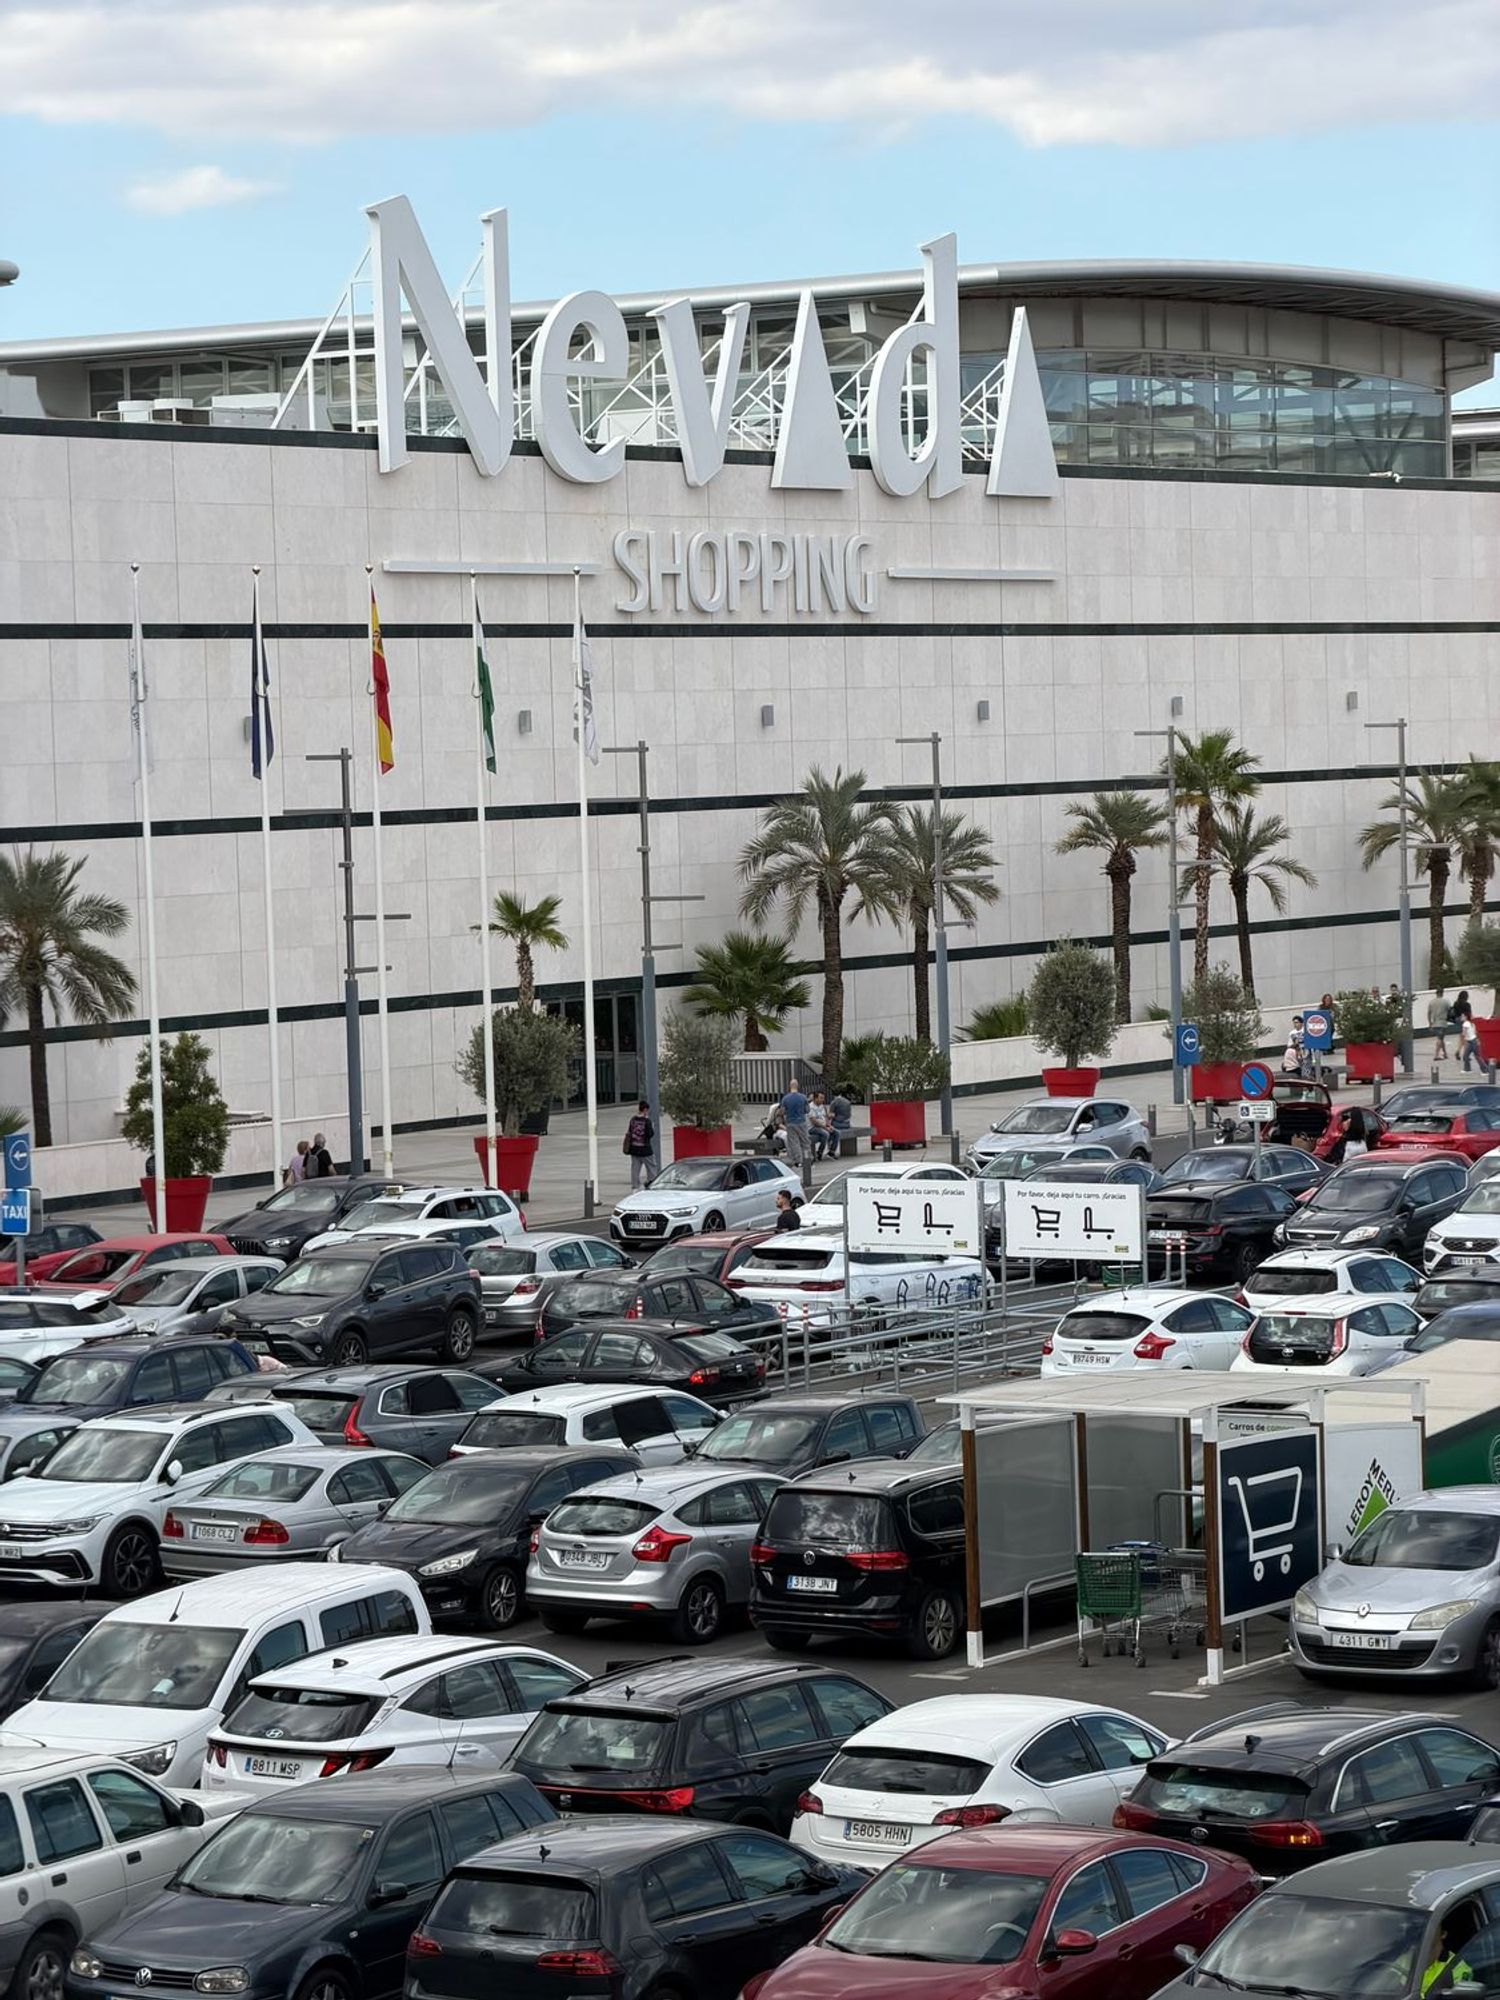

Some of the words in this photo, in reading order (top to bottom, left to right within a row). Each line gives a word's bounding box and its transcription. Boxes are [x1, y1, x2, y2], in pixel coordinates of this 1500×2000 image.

[613, 529, 878, 614] SHOPPING
[2, 1205, 27, 1219] TAXI
[1228, 1422, 1255, 1431] Carros
[1255, 1423, 1265, 1431] de
[1369, 1457, 1401, 1505] MERL
[1345, 1473, 1374, 1537] LEROY
[1338, 1635, 1364, 1647] 4311
[251, 1759, 277, 1773] 8811
[279, 1762, 301, 1775] MSP
[852, 1823, 881, 1839] 5805
[884, 1826, 909, 1841] HHN
